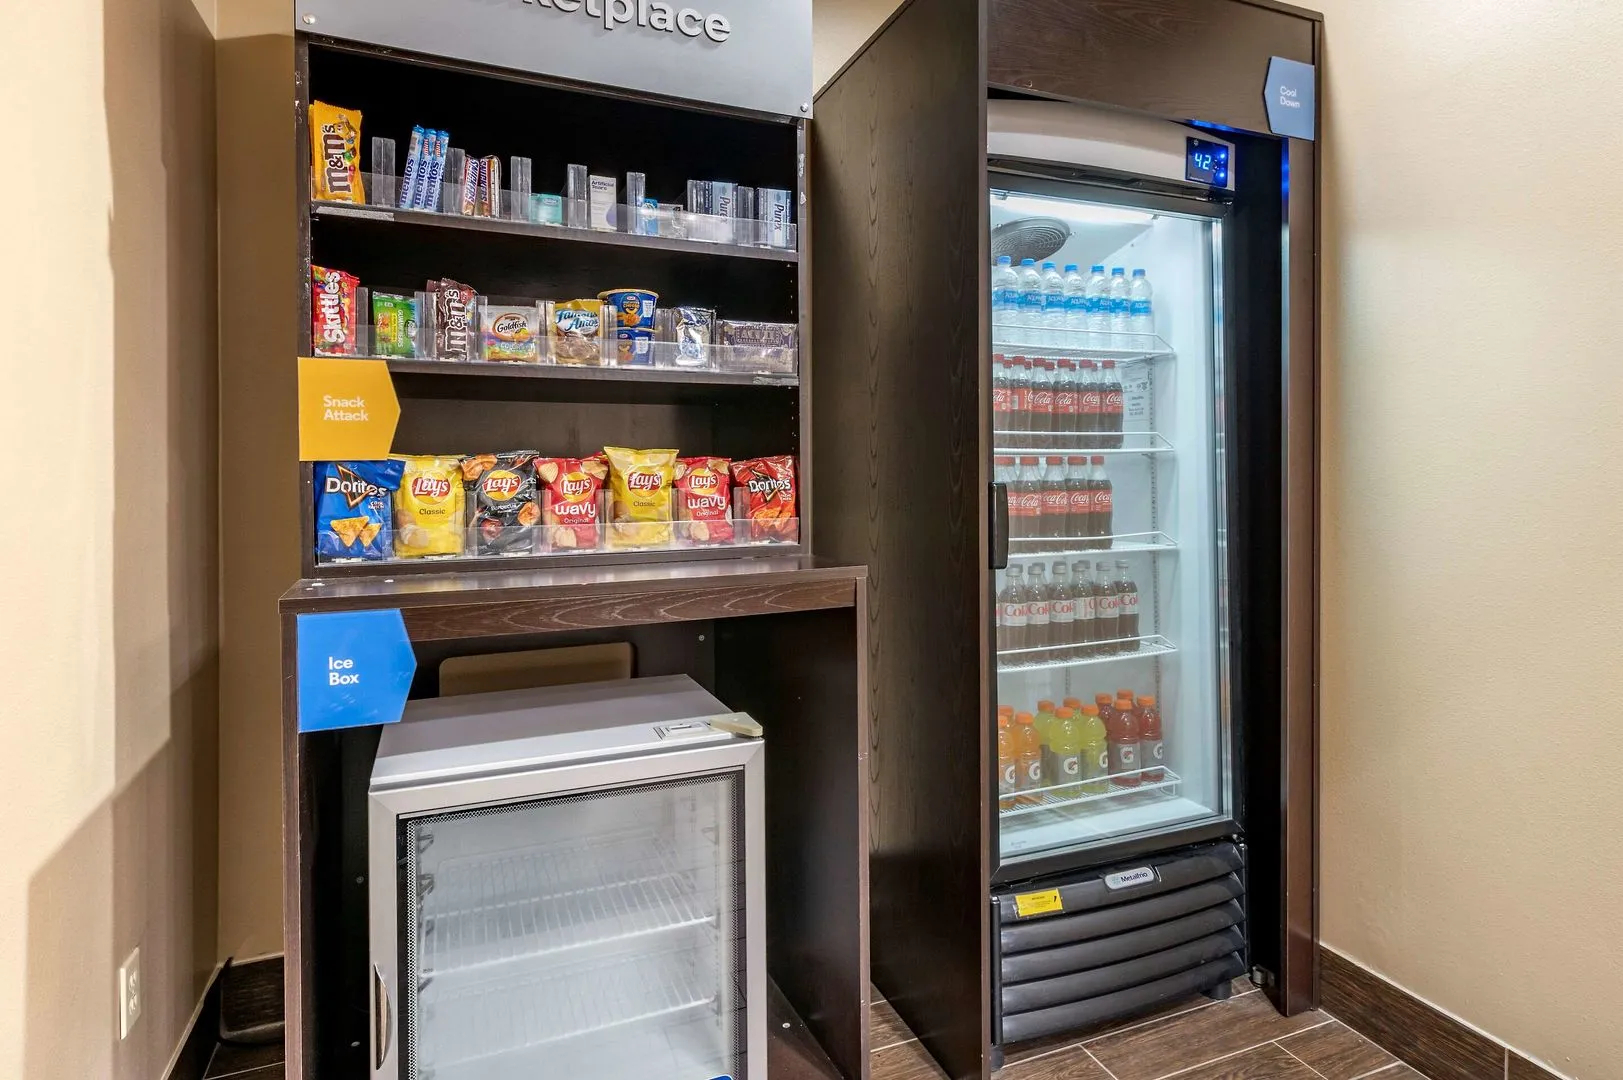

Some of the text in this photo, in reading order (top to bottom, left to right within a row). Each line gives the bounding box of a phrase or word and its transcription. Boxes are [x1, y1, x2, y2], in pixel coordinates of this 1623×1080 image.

[521, 0, 731, 42] place
[1280, 85, 1297, 97] Cool
[1280, 96, 1300, 108] Down
[1195, 153, 1211, 170] 42
[400, 158, 414, 205] mentos
[414, 159, 427, 206] mentos
[426, 160, 440, 207] mentos
[774, 203, 785, 231] Purex
[320, 271, 345, 343] Skittles
[497, 321, 527, 332] Goldfish
[323, 394, 365, 408] Snack
[323, 408, 369, 421] Attack
[326, 477, 387, 497] Doritos
[749, 480, 791, 493] Doritos
[555, 501, 596, 517] wavy
[687, 495, 726, 509] wavy
[419, 507, 446, 516] Classic
[328, 655, 354, 670] Ice
[328, 671, 360, 686] Box
[1063, 757, 1078, 775] G
[1120, 872, 1148, 882] Metalfrio
